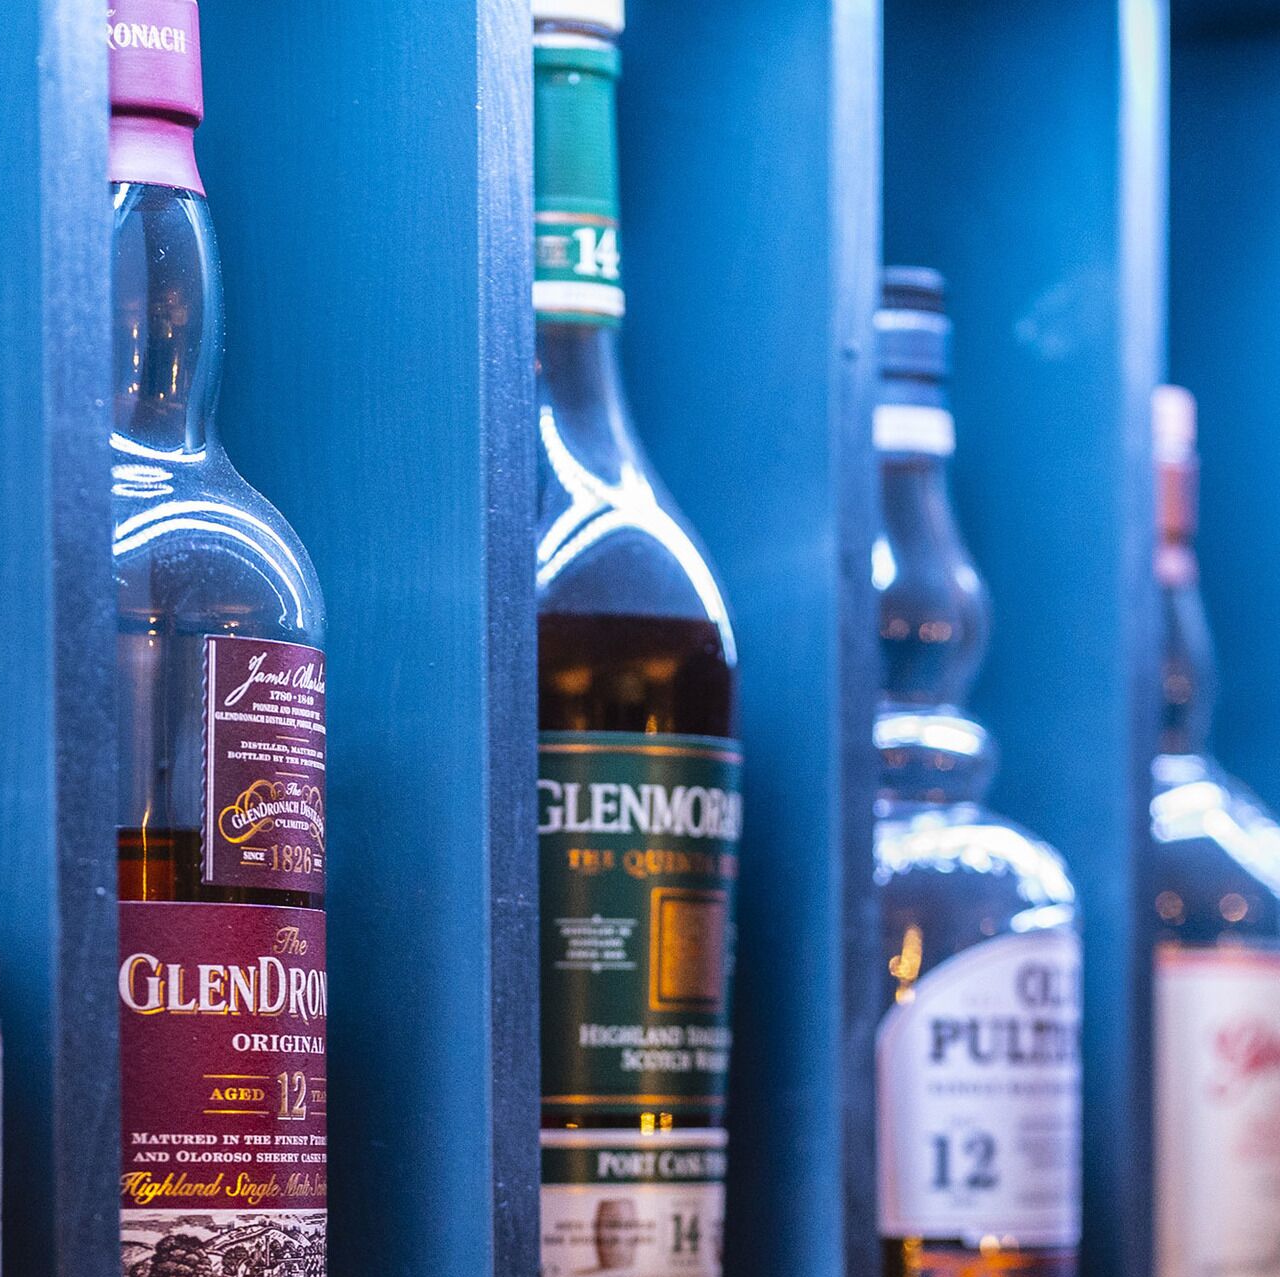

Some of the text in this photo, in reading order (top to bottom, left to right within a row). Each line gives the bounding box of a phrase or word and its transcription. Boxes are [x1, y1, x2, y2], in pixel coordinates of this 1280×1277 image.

[572, 226, 620, 280] 14
[224, 651, 292, 706] James
[214, 711, 265, 724] GLENDRONACH
[227, 751, 272, 762] BOTTLED
[240, 740, 290, 754] DISTILLED,
[242, 851, 266, 862] SINCE
[271, 844, 312, 874] 1826
[273, 925, 308, 956] The
[232, 1033, 325, 1055] ORIGINAL
[209, 1087, 266, 1101] AGED
[276, 1071, 307, 1120] 12
[130, 1132, 219, 1145] MATURED
[222, 1134, 241, 1146] IN
[243, 1134, 272, 1146] THE
[273, 1135, 309, 1146] FINEST
[133, 1151, 171, 1163] AND
[175, 1150, 253, 1163] OLOROSO
[255, 1152, 300, 1163] SHERRY
[120, 1171, 225, 1206] Highland
[225, 1171, 282, 1205] Single
[672, 1213, 702, 1254] 14
